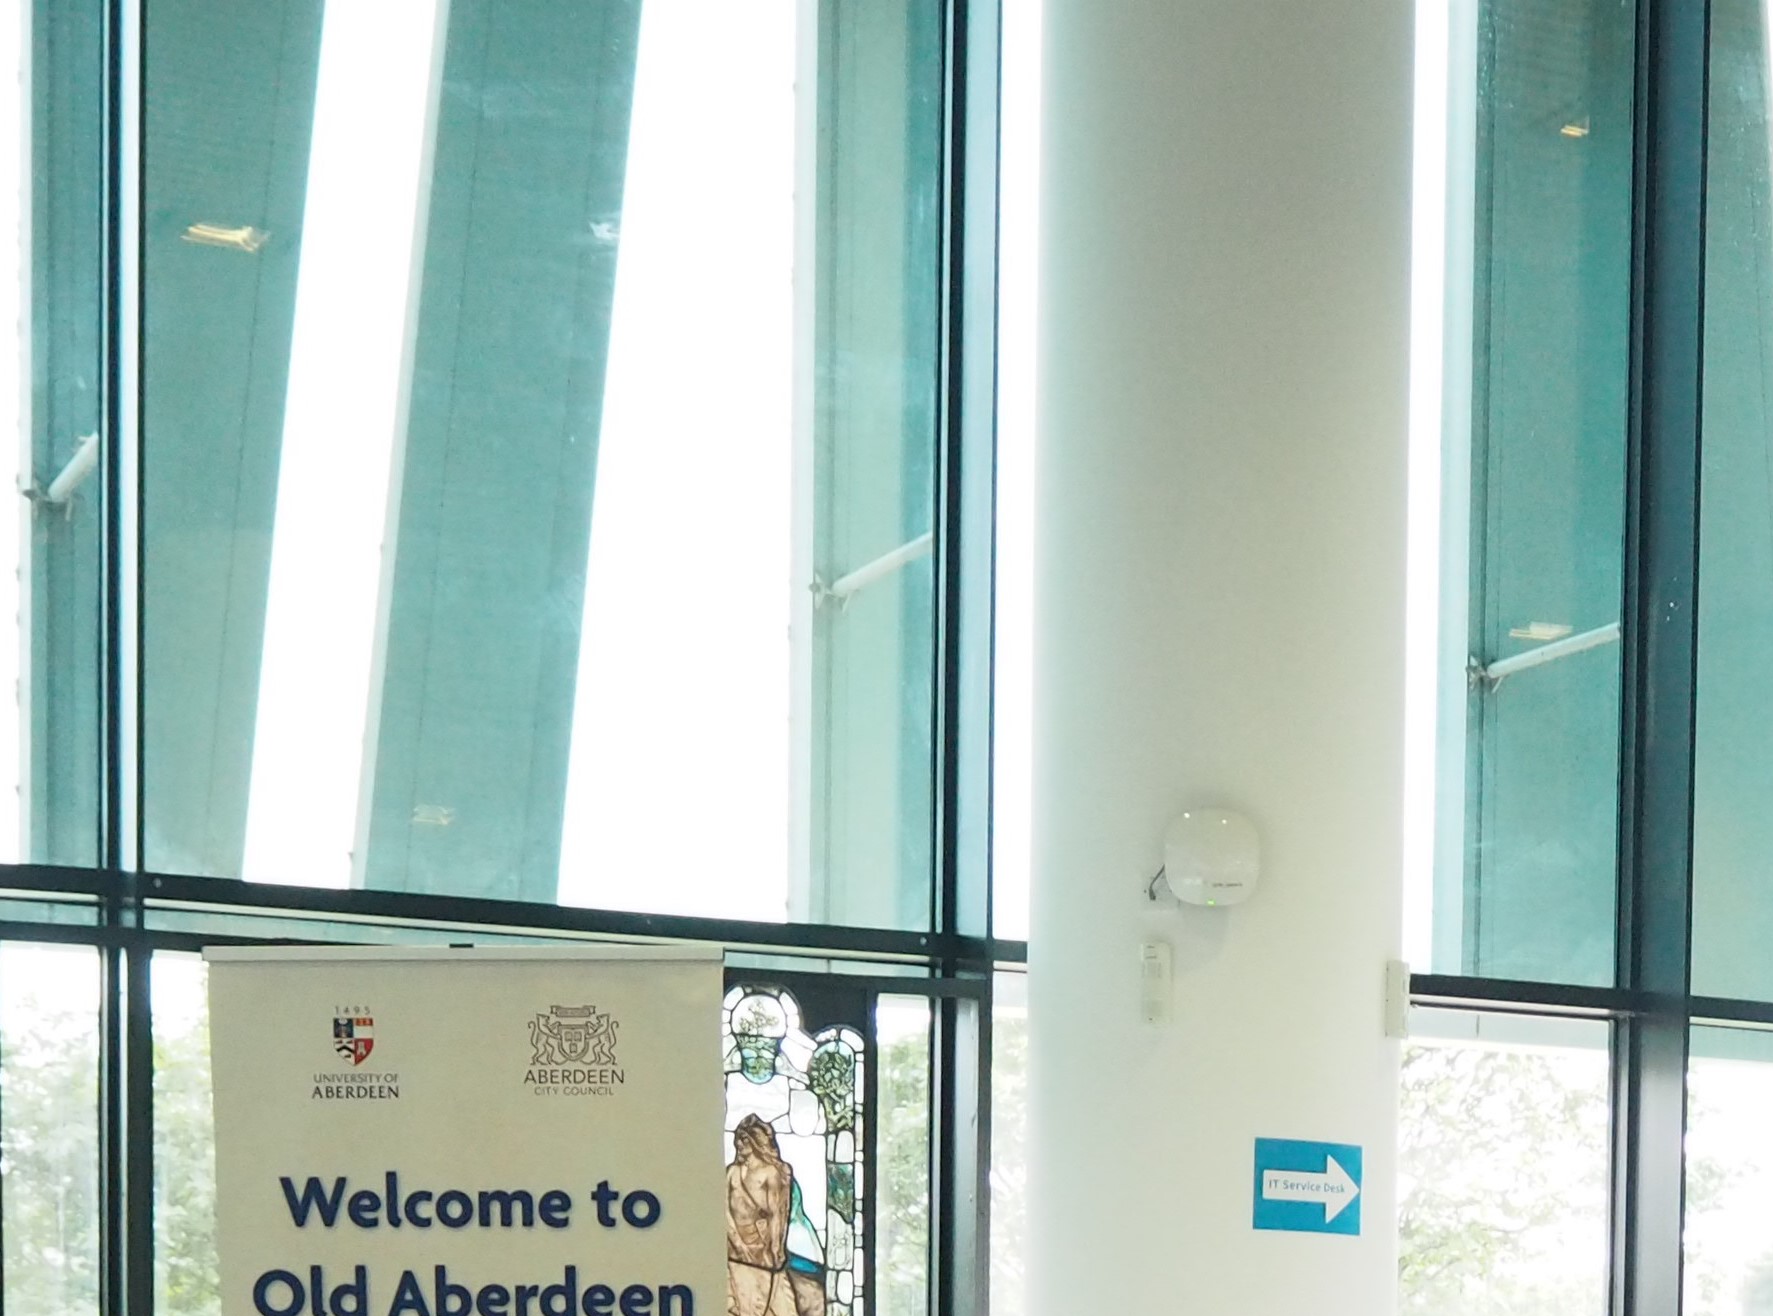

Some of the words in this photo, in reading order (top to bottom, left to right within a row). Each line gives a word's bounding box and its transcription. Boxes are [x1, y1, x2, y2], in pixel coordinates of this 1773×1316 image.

[313, 1073, 381, 1084] UNIVERSITY
[384, 1073, 398, 1083] OF
[524, 1069, 625, 1084] ABERDEEN
[312, 1086, 399, 1099] ABERDEEN
[534, 1087, 559, 1095] CITY
[563, 1087, 614, 1095] COUNCIL
[1268, 1179, 1280, 1190] IT
[1282, 1180, 1321, 1192] Service
[1323, 1182, 1345, 1194] Desk
[280, 1171, 572, 1228] Welcome
[591, 1180, 661, 1228] to
